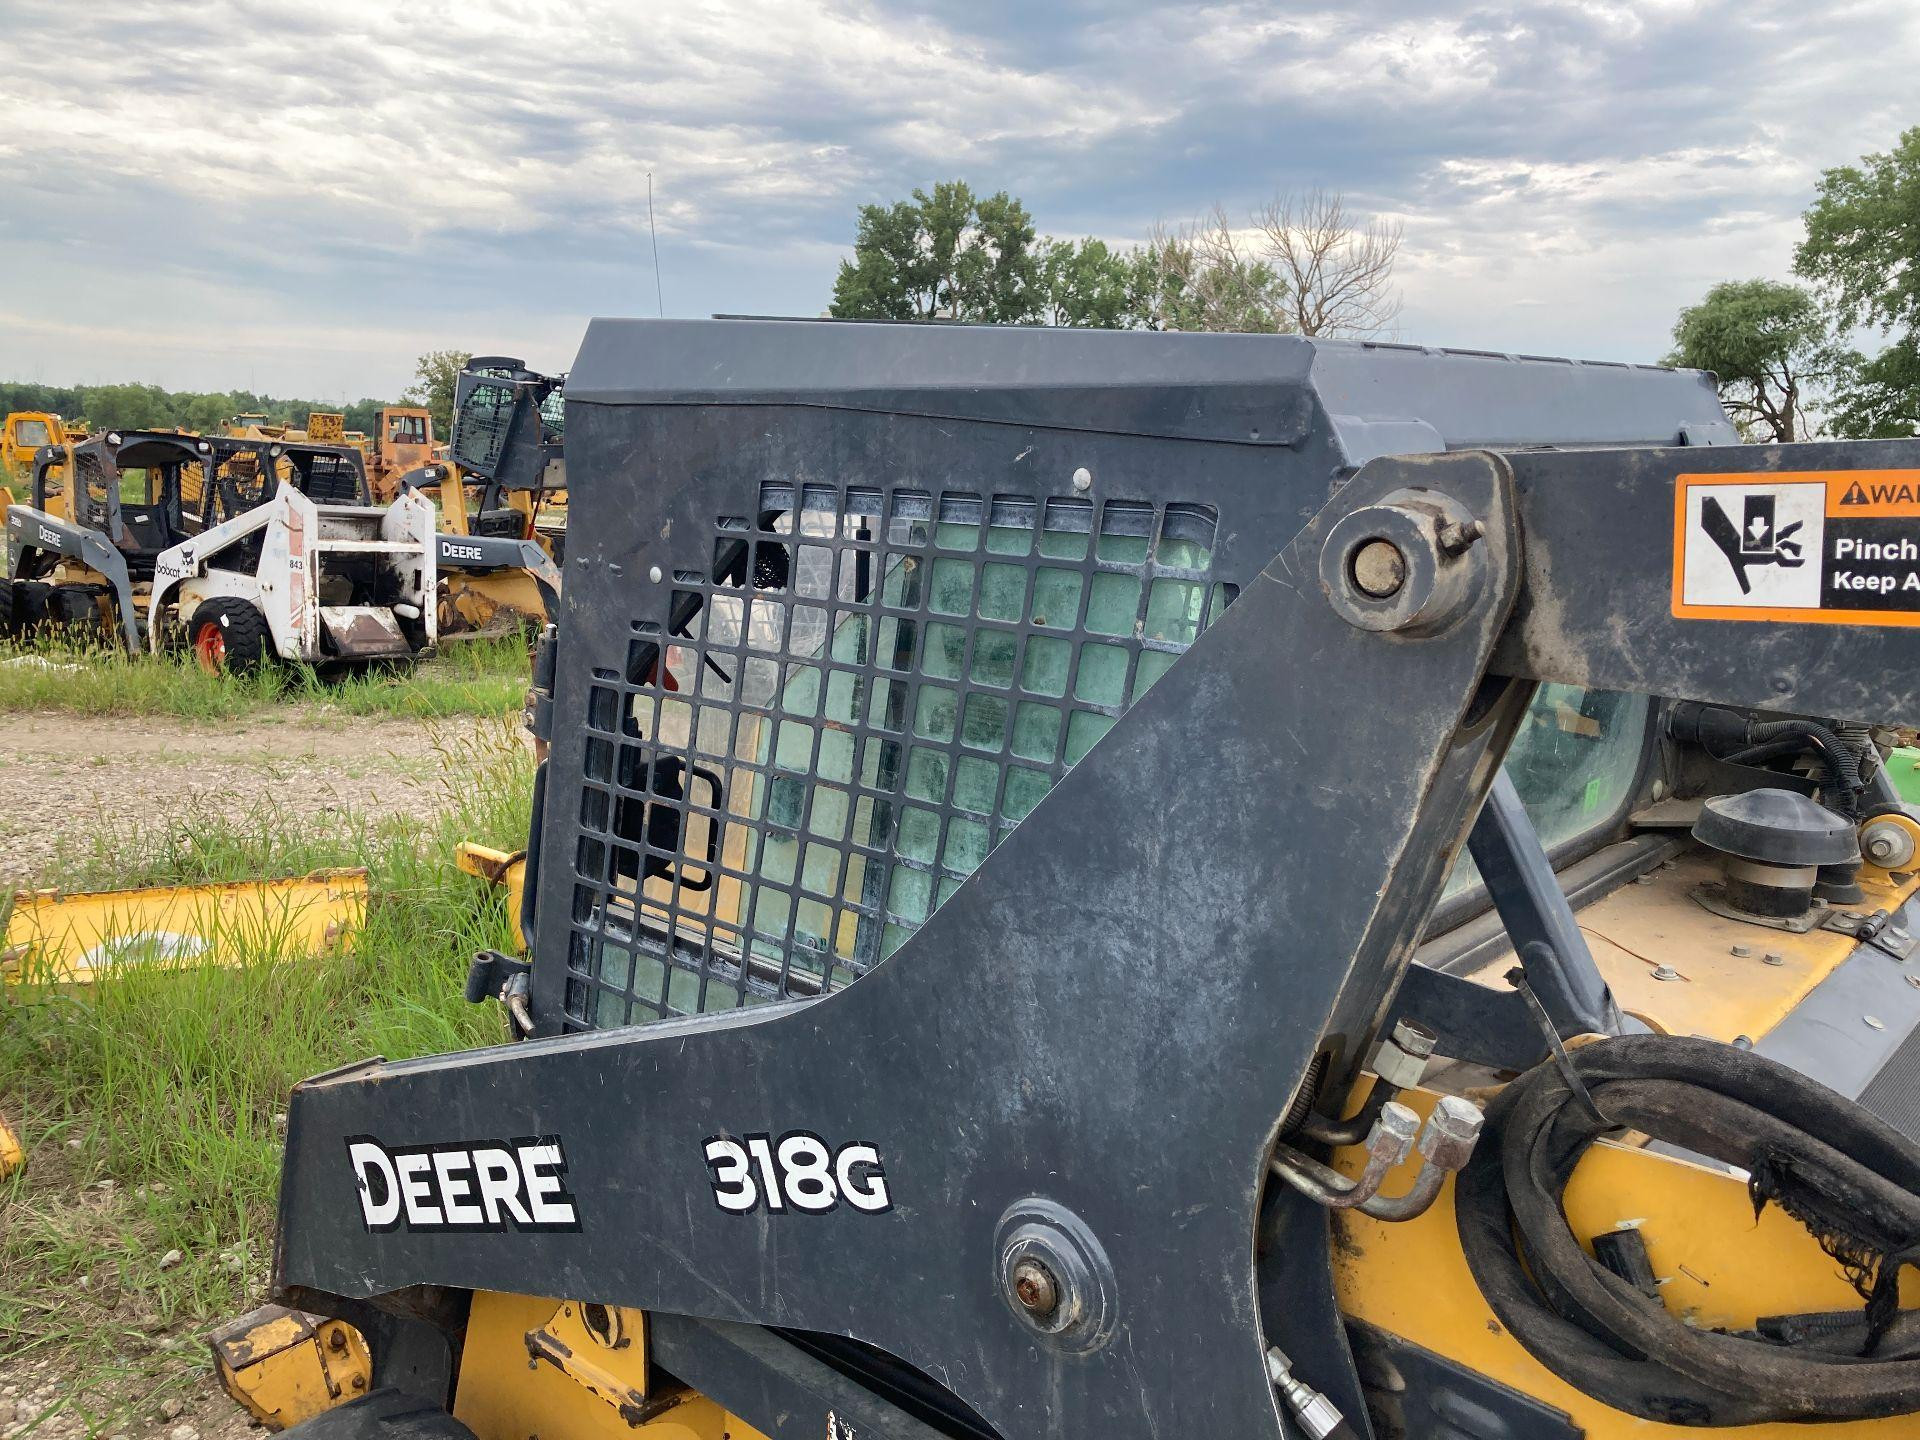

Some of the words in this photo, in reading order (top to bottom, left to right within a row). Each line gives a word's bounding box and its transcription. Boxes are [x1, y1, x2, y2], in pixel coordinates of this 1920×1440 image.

[1869, 484, 1920, 504] WA
[40, 525, 61, 547] DEERE
[442, 541, 482, 560] DEERE
[1835, 538, 1918, 560] Pinch
[156, 561, 181, 578] bobcat
[289, 559, 303, 570] 843
[1834, 571, 1897, 594] Keep
[349, 1143, 576, 1225] DEERE
[705, 1136, 889, 1210] 318G
